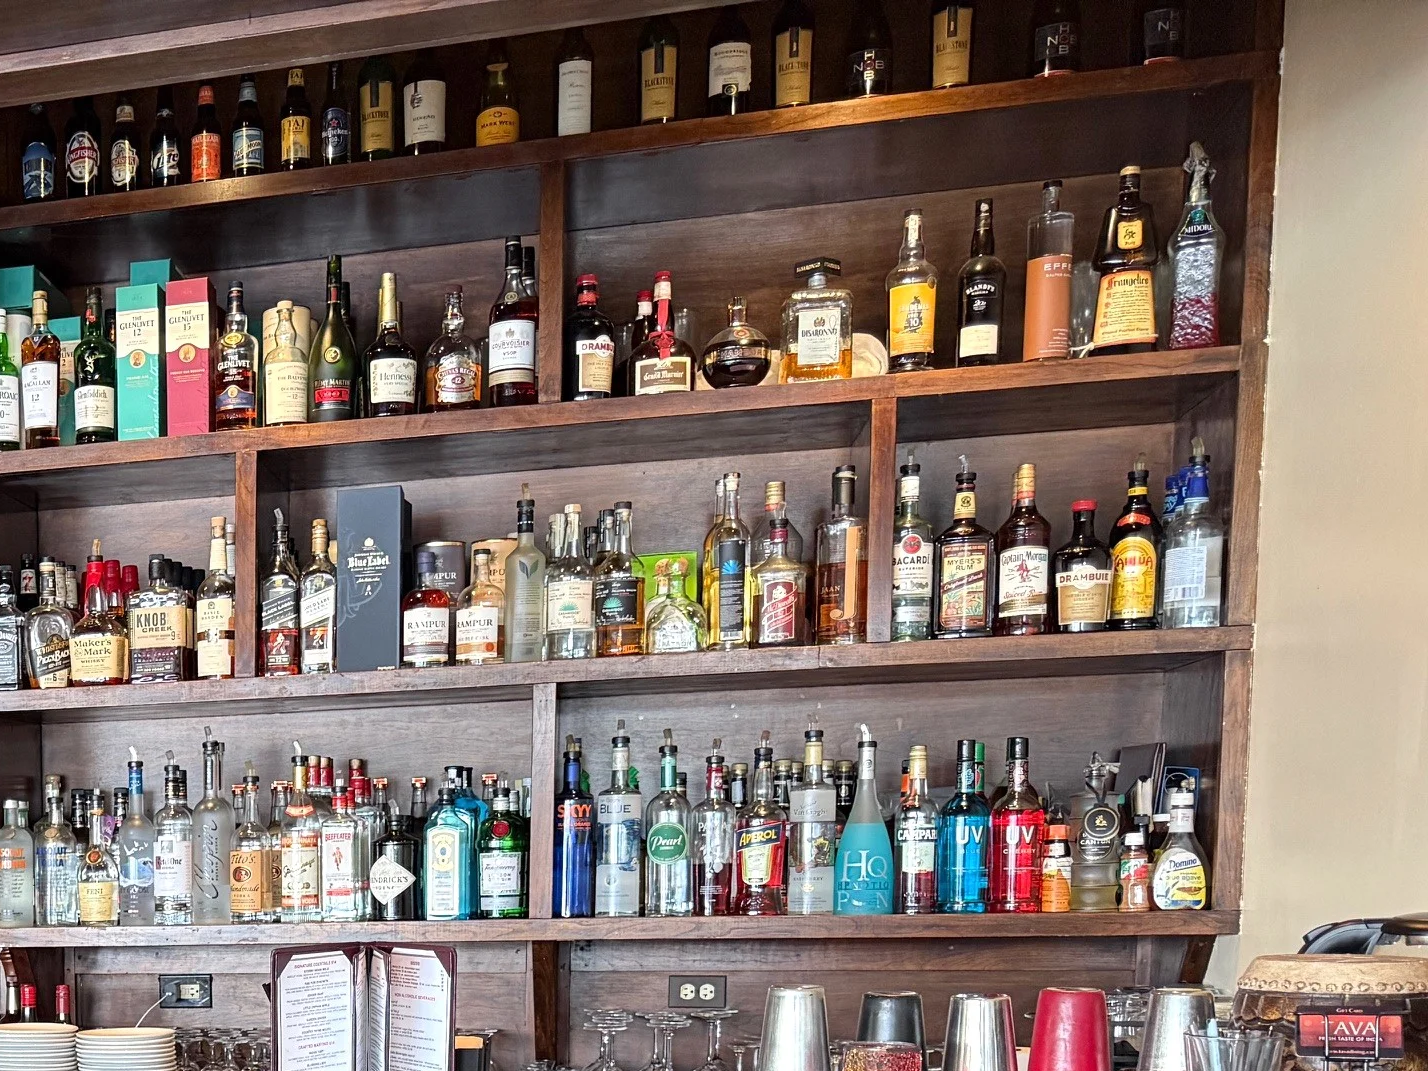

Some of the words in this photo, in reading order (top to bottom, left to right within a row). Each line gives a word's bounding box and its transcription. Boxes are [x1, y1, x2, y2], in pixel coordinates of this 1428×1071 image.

[778, 60, 809, 72] BLACKTONE
[965, 281, 995, 295] BLANDY'S
[168, 313, 205, 325] GLENLIVET
[909, 318, 919, 327] 10
[119, 319, 155, 331] GLENLIVET
[183, 323, 191, 331] 15
[133, 328, 142, 337] 12
[801, 328, 837, 339] DISARONNO
[491, 340, 530, 351] COURVOISIER
[217, 359, 250, 371] GLENLIVET
[437, 367, 459, 380] CHIVAS
[31, 393, 40, 402] 12
[347, 557, 367, 569] Blue
[367, 555, 390, 566] Label
[1001, 552, 1024, 566] Captain
[432, 571, 457, 580] MPUR
[1059, 572, 1109, 584] DRAMBUIE
[136, 612, 167, 628] KNOB
[407, 620, 446, 630] RAMPUR
[457, 618, 494, 629] RAMPUR
[142, 625, 173, 633] CREEK
[171, 631, 176, 641] 9
[74, 639, 112, 648] Maker's
[83, 647, 112, 656] Mark
[52, 673, 58, 682] 6
[557, 803, 592, 819] SKYY
[600, 804, 632, 815] BLUE
[325, 832, 352, 842] BEEFEATER
[739, 828, 778, 847] APEROL
[897, 828, 938, 841] CAMPAR
[955, 825, 984, 845] UV
[1006, 825, 1035, 845] UV
[650, 834, 683, 852] Pearl
[172, 858, 182, 866] One
[230, 854, 256, 865] Tito's
[1168, 858, 1198, 869] Domino
[841, 850, 888, 882] HQ
[371, 875, 409, 884] NDRICK'S
